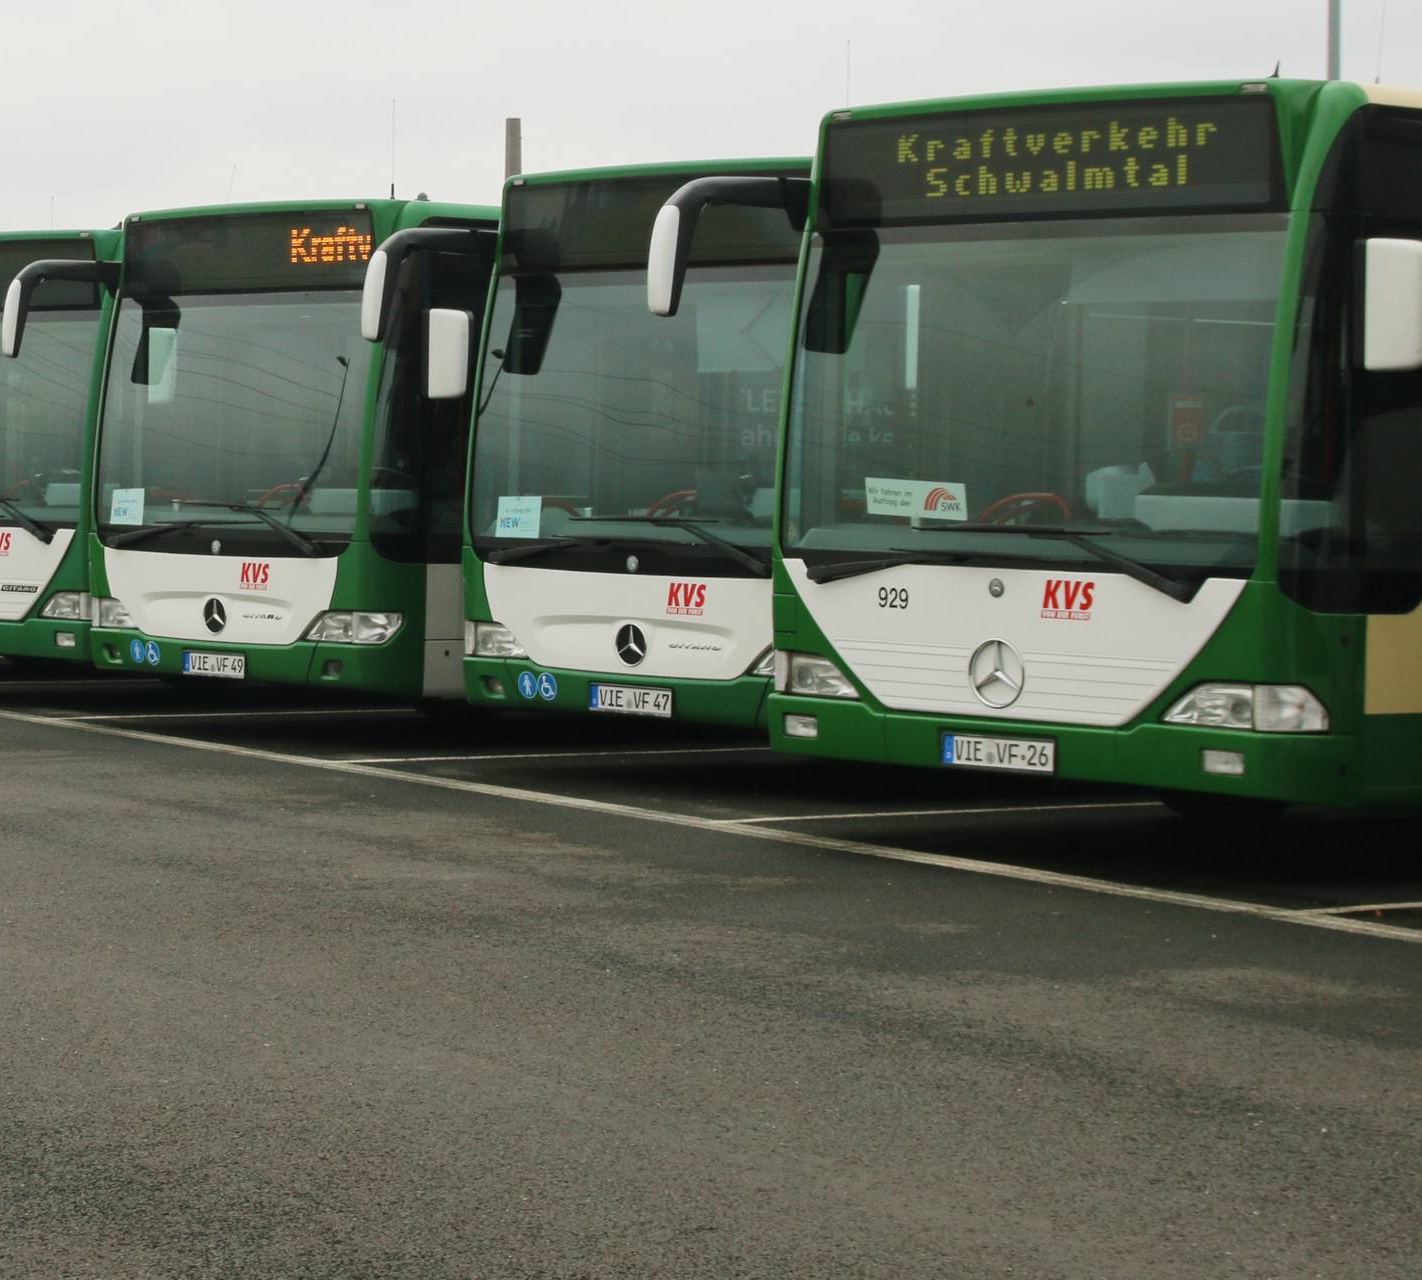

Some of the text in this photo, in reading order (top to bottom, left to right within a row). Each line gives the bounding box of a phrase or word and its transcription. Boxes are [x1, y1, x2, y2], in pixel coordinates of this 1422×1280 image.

[897, 117, 1217, 163] Kraftverkehr
[926, 154, 1187, 197] Schwalmtal
[940, 501, 962, 512] SWK
[241, 562, 270, 584] KVS
[667, 582, 707, 608] KVS
[877, 586, 909, 609] 929
[1042, 579, 1095, 611] KVS
[190, 655, 244, 673] VIE VF 49
[599, 689, 670, 711] VIE VF 47
[955, 739, 1049, 767] VIE VF 26
